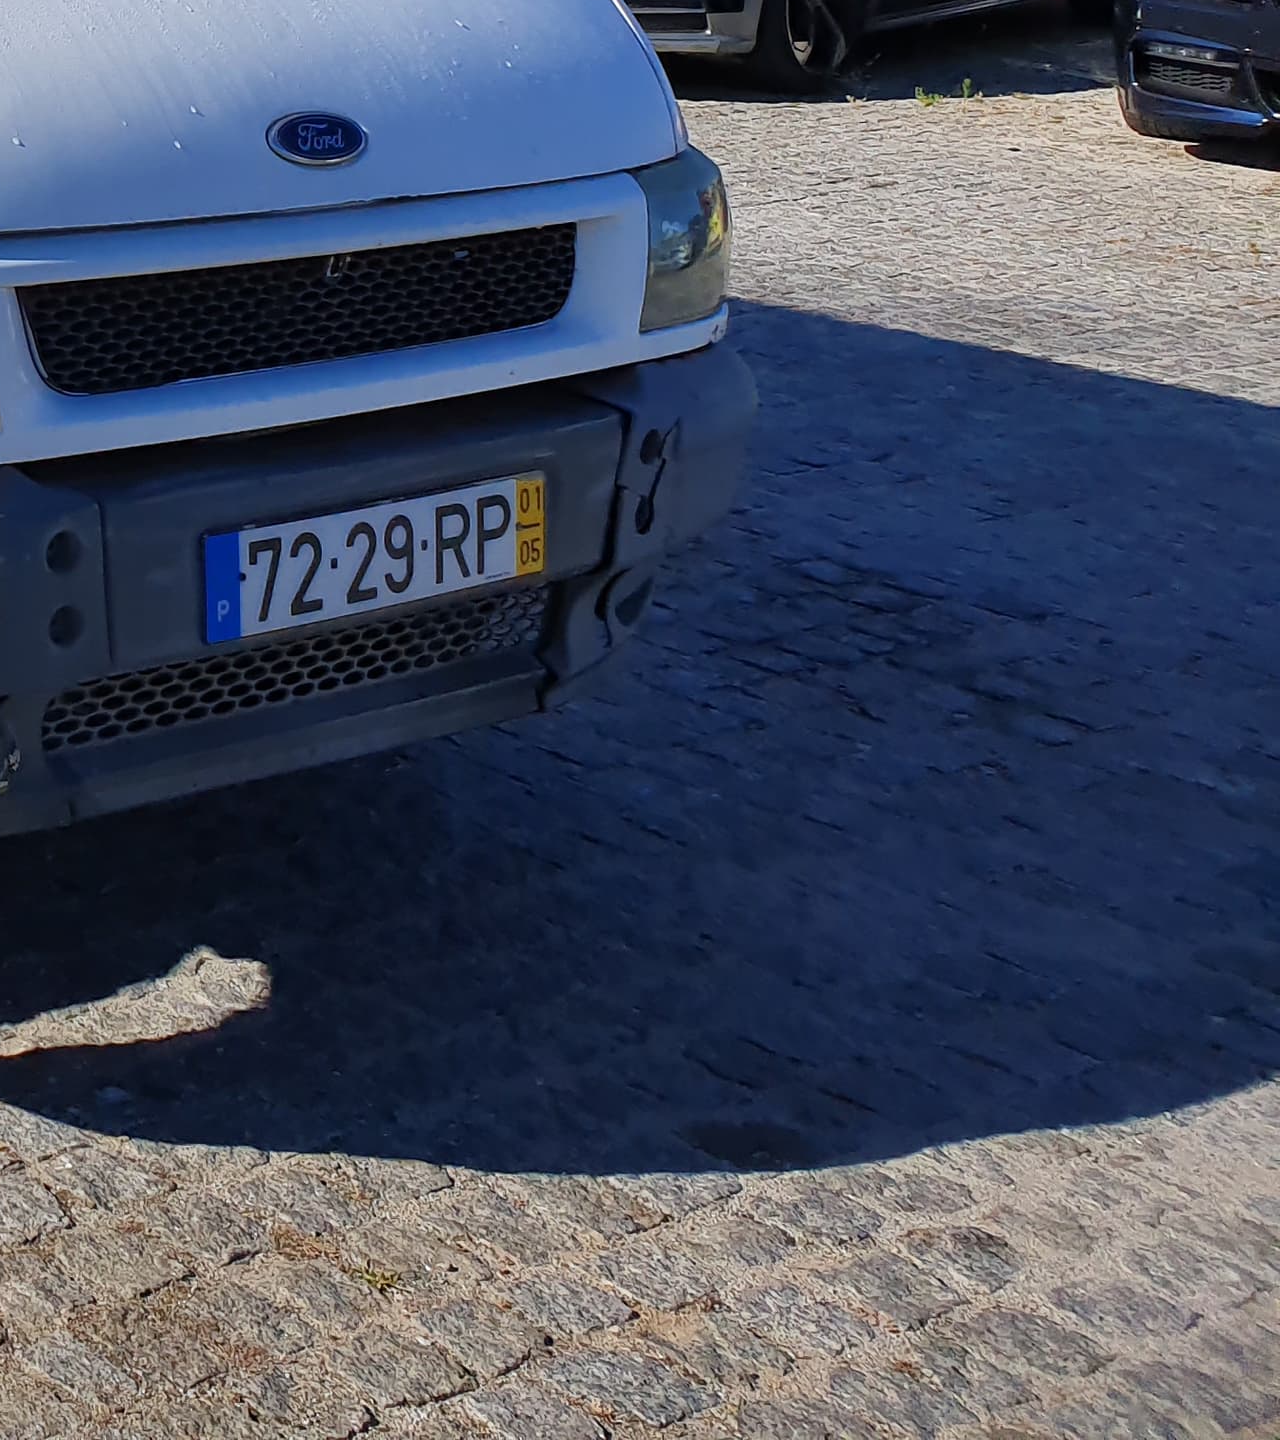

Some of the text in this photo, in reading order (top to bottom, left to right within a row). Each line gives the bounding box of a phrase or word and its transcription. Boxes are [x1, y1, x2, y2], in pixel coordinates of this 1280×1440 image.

[297, 123, 344, 151] Ford
[520, 485, 541, 514] 01
[520, 538, 541, 566] 05
[217, 600, 230, 622] P
